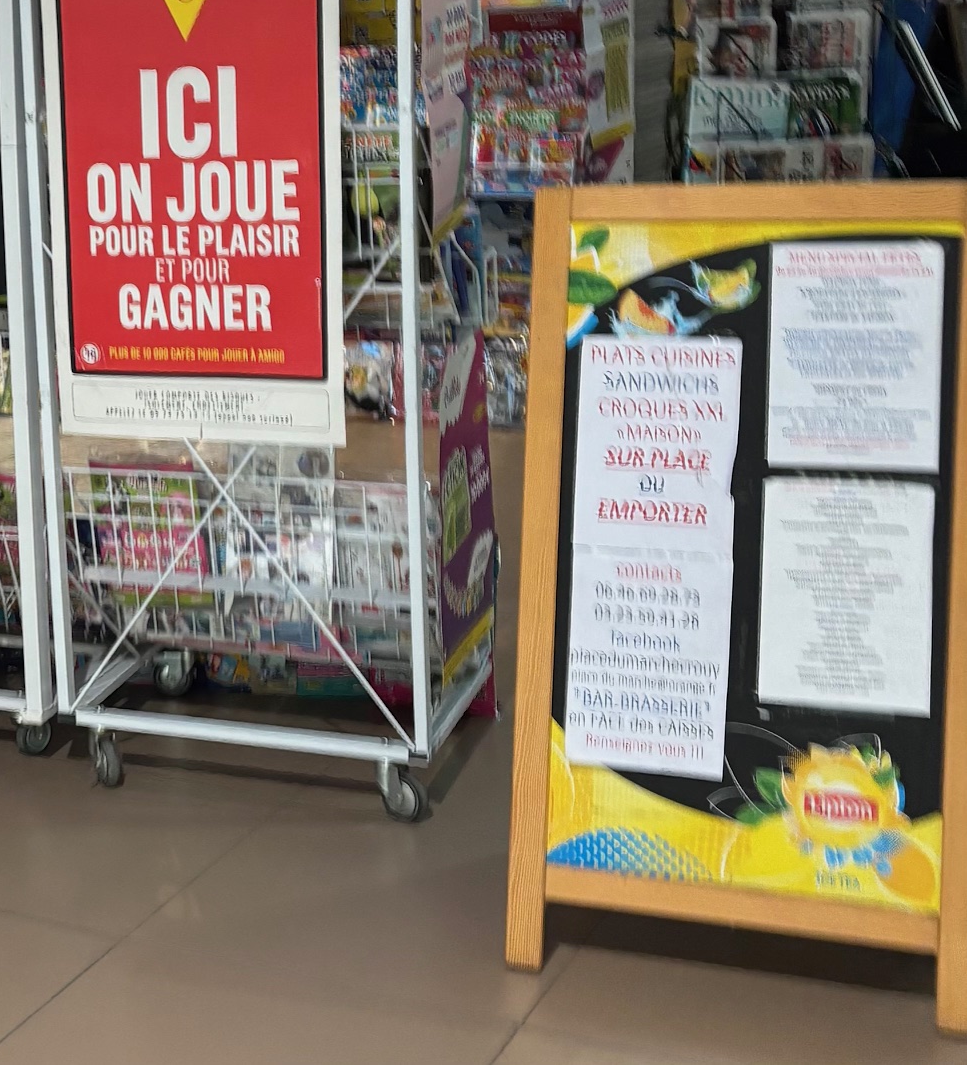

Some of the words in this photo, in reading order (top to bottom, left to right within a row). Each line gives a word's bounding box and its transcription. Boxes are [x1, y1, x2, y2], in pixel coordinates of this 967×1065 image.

[139, 66, 238, 160] ICI
[86, 162, 152, 224] ON
[166, 159, 300, 223] JOUE
[90, 225, 153, 257] POUR
[162, 225, 190, 257] LE
[199, 224, 300, 257] PLAISIR
[155, 258, 176, 283] ET
[181, 258, 230, 283] POUR
[119, 284, 272, 332] GAGNER
[109, 346, 129, 360] PLUS
[130, 346, 140, 361] DE
[197, 347, 219, 362] POUR
[591, 345, 646, 366] PLATS
[603, 371, 719, 396] SANDWICHS
[603, 446, 644, 468] SUR
[651, 446, 711, 472] PLACE
[639, 474, 665, 493] OU
[596, 498, 708, 525] EMPORTER
